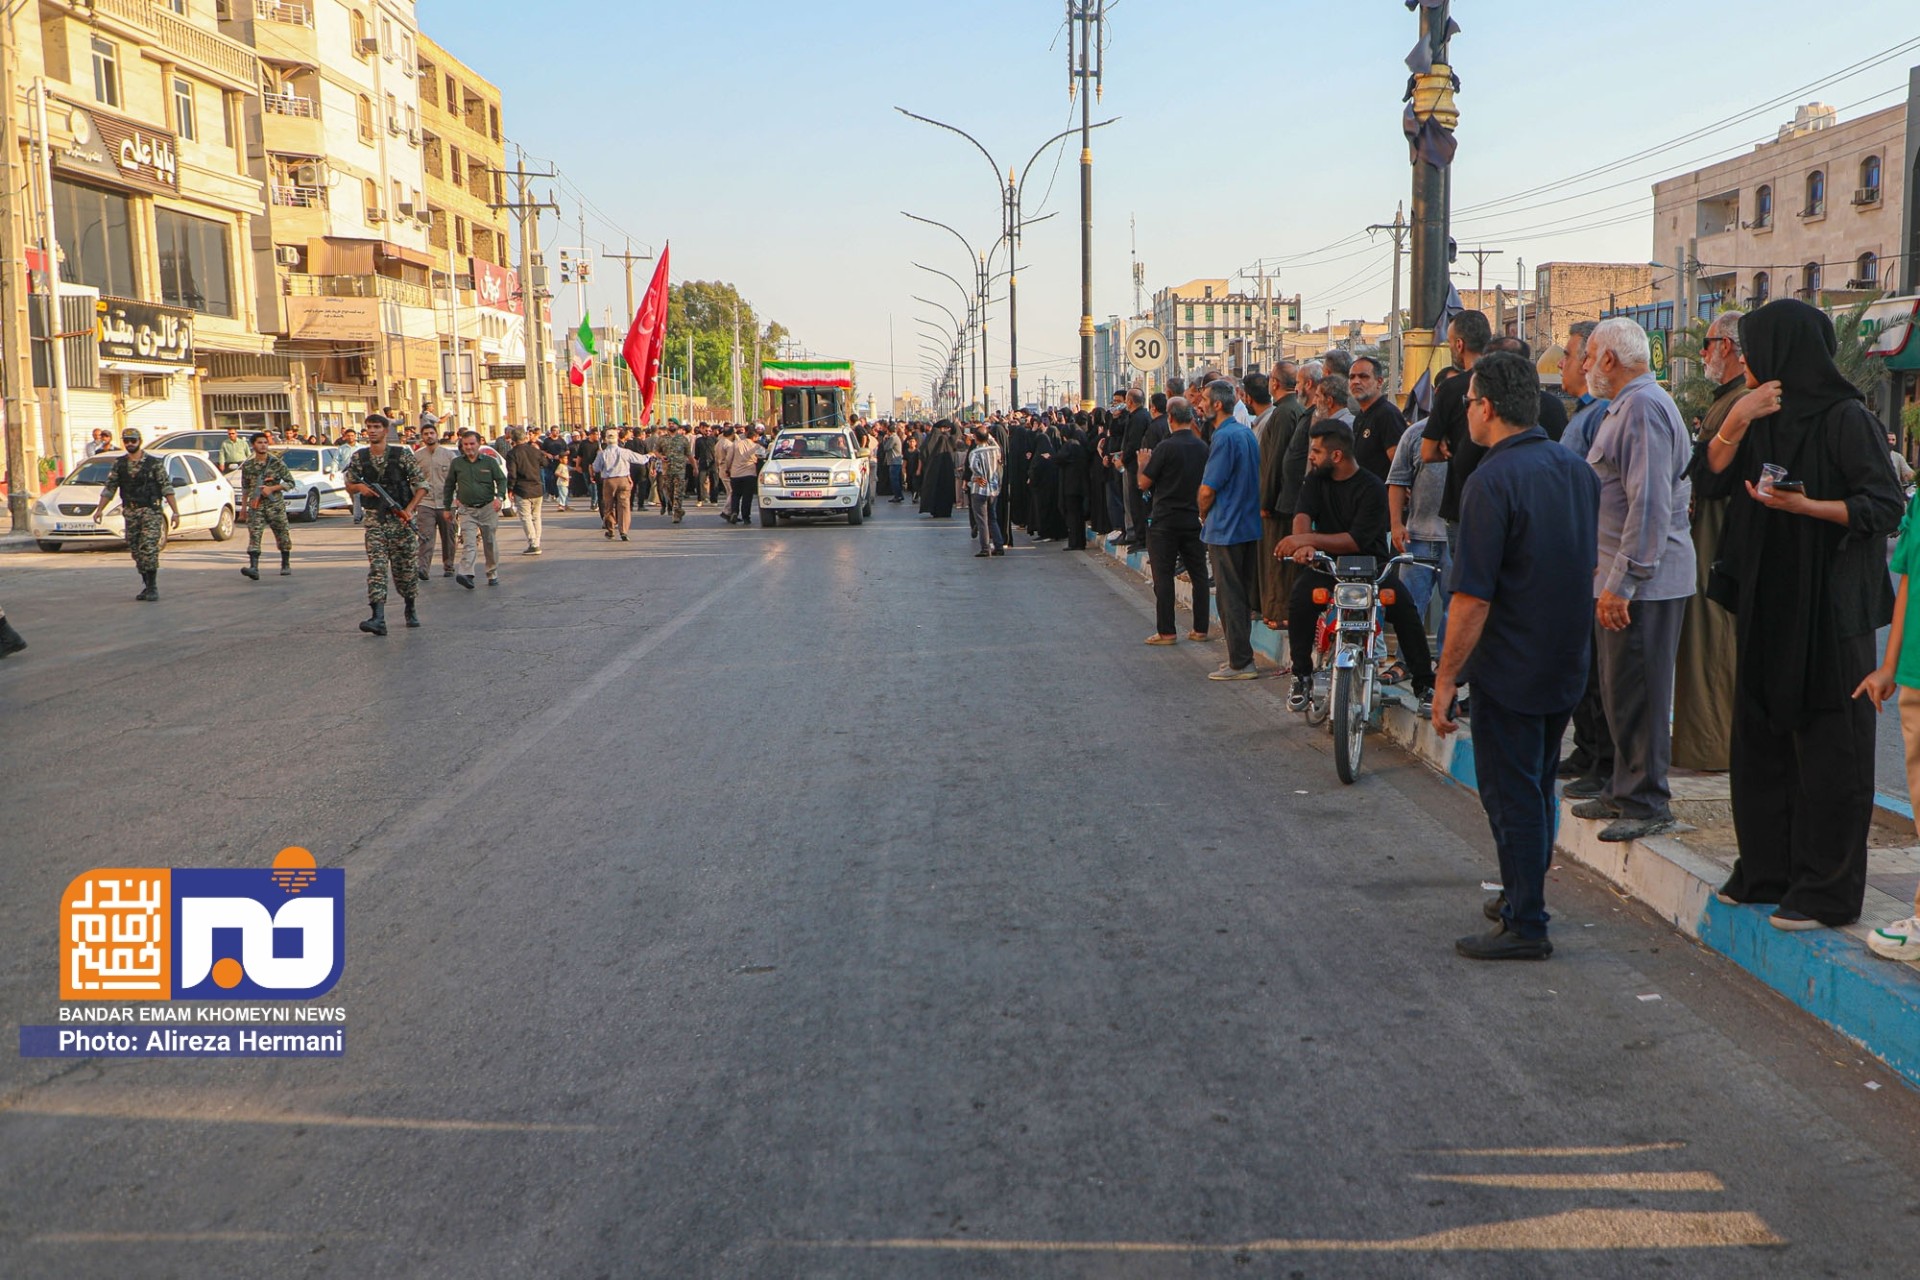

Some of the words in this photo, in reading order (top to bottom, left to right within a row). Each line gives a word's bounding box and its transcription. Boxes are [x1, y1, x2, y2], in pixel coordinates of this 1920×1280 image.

[120, 132, 151, 170] علی
[151, 138, 175, 184] بابا
[136, 314, 178, 357] گالری
[1134, 339, 1161, 359] 30
